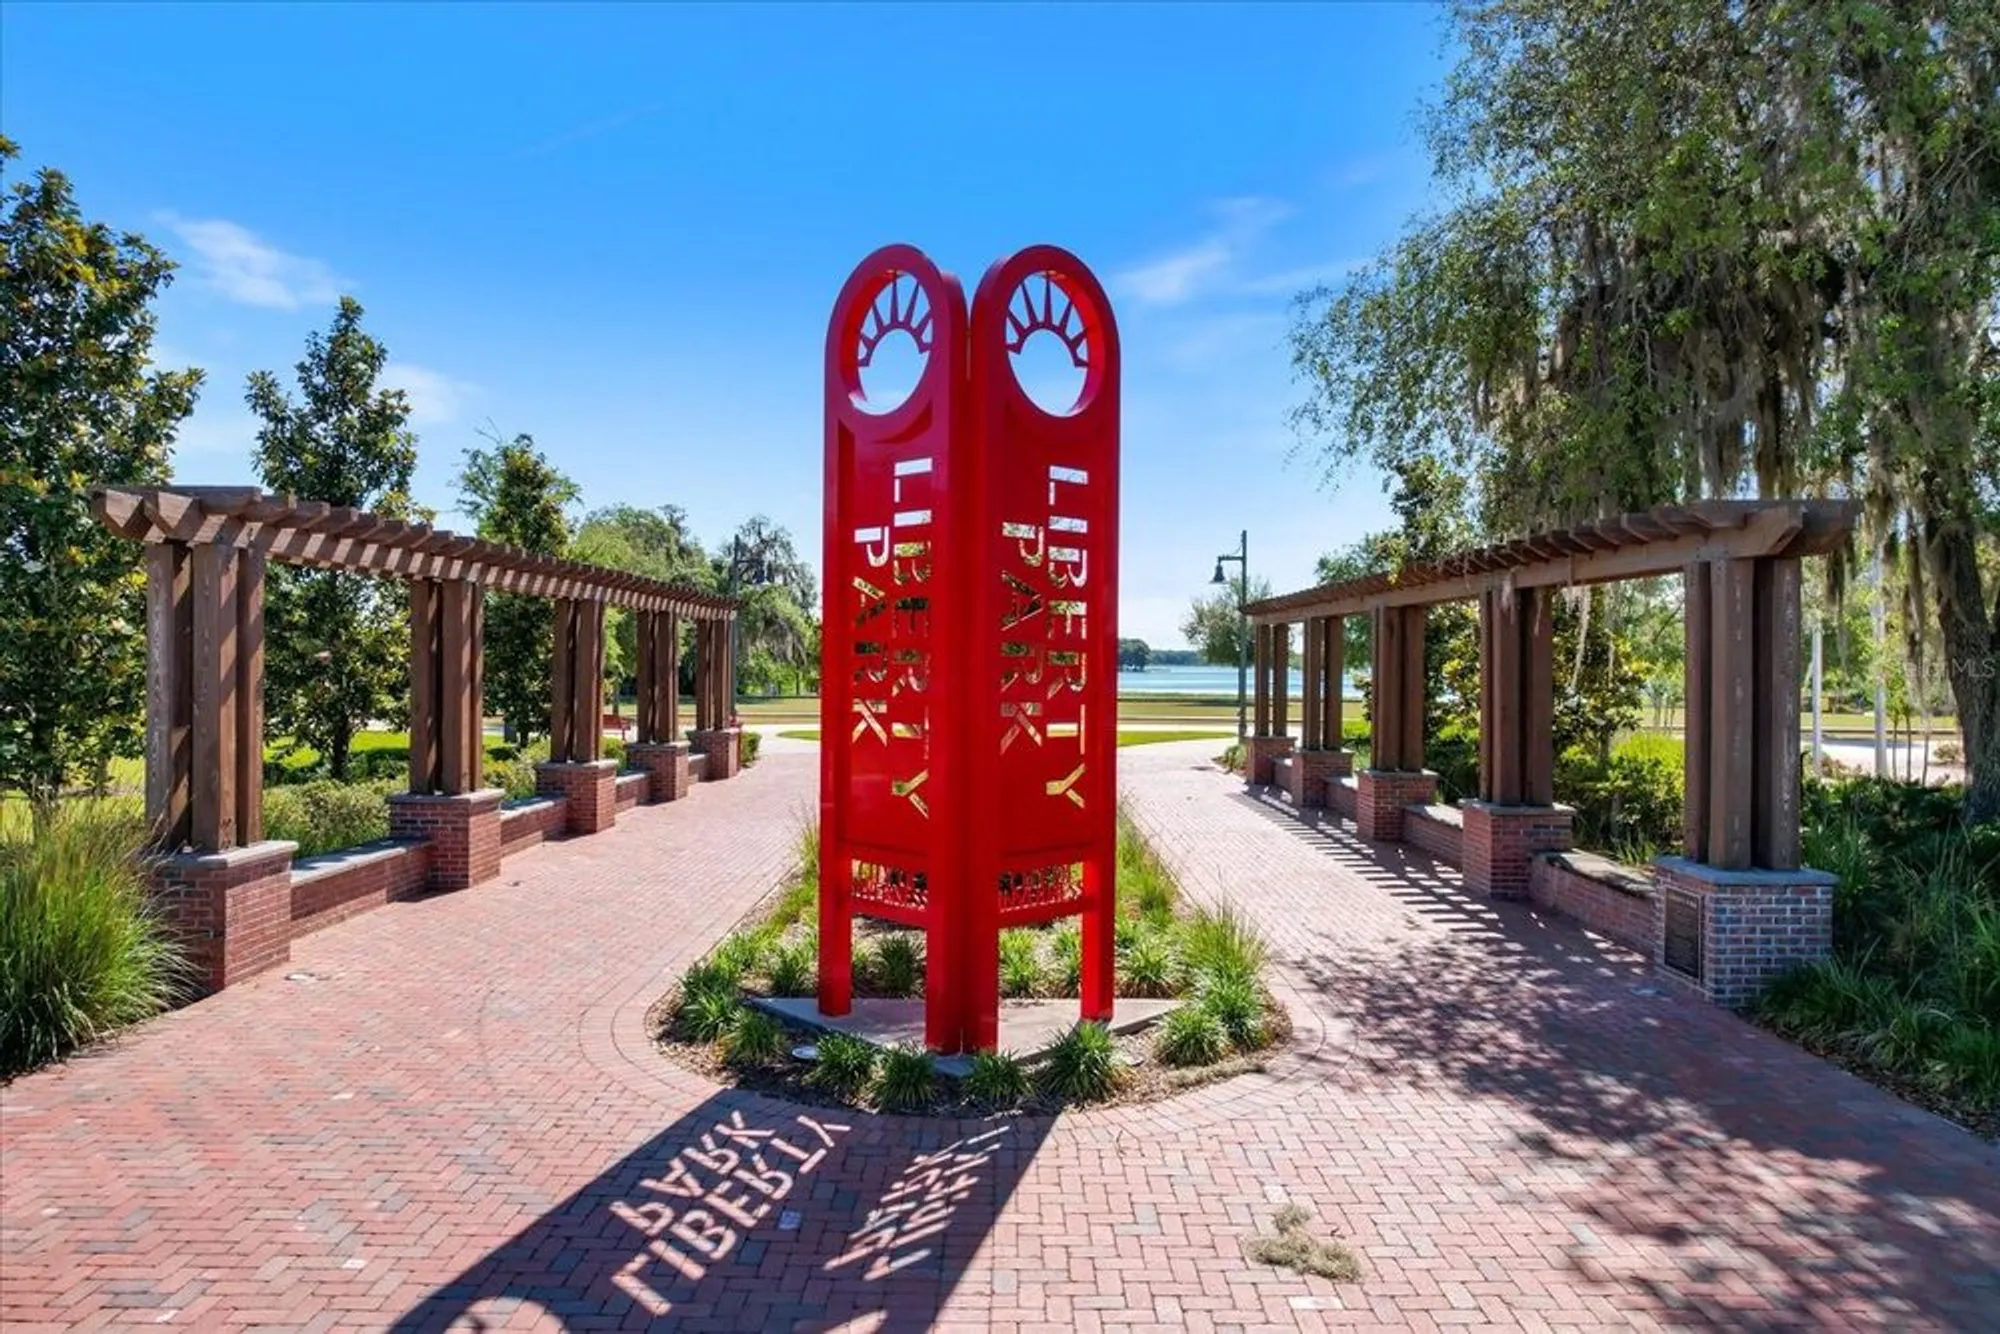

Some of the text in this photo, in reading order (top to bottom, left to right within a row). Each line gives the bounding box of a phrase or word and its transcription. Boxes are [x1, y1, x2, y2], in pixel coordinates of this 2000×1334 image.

[853, 526, 889, 746] PARK
[893, 458, 932, 818] LIBERTY
[1001, 523, 1043, 754] PARK
[1047, 466, 1088, 808] LIBERTY
